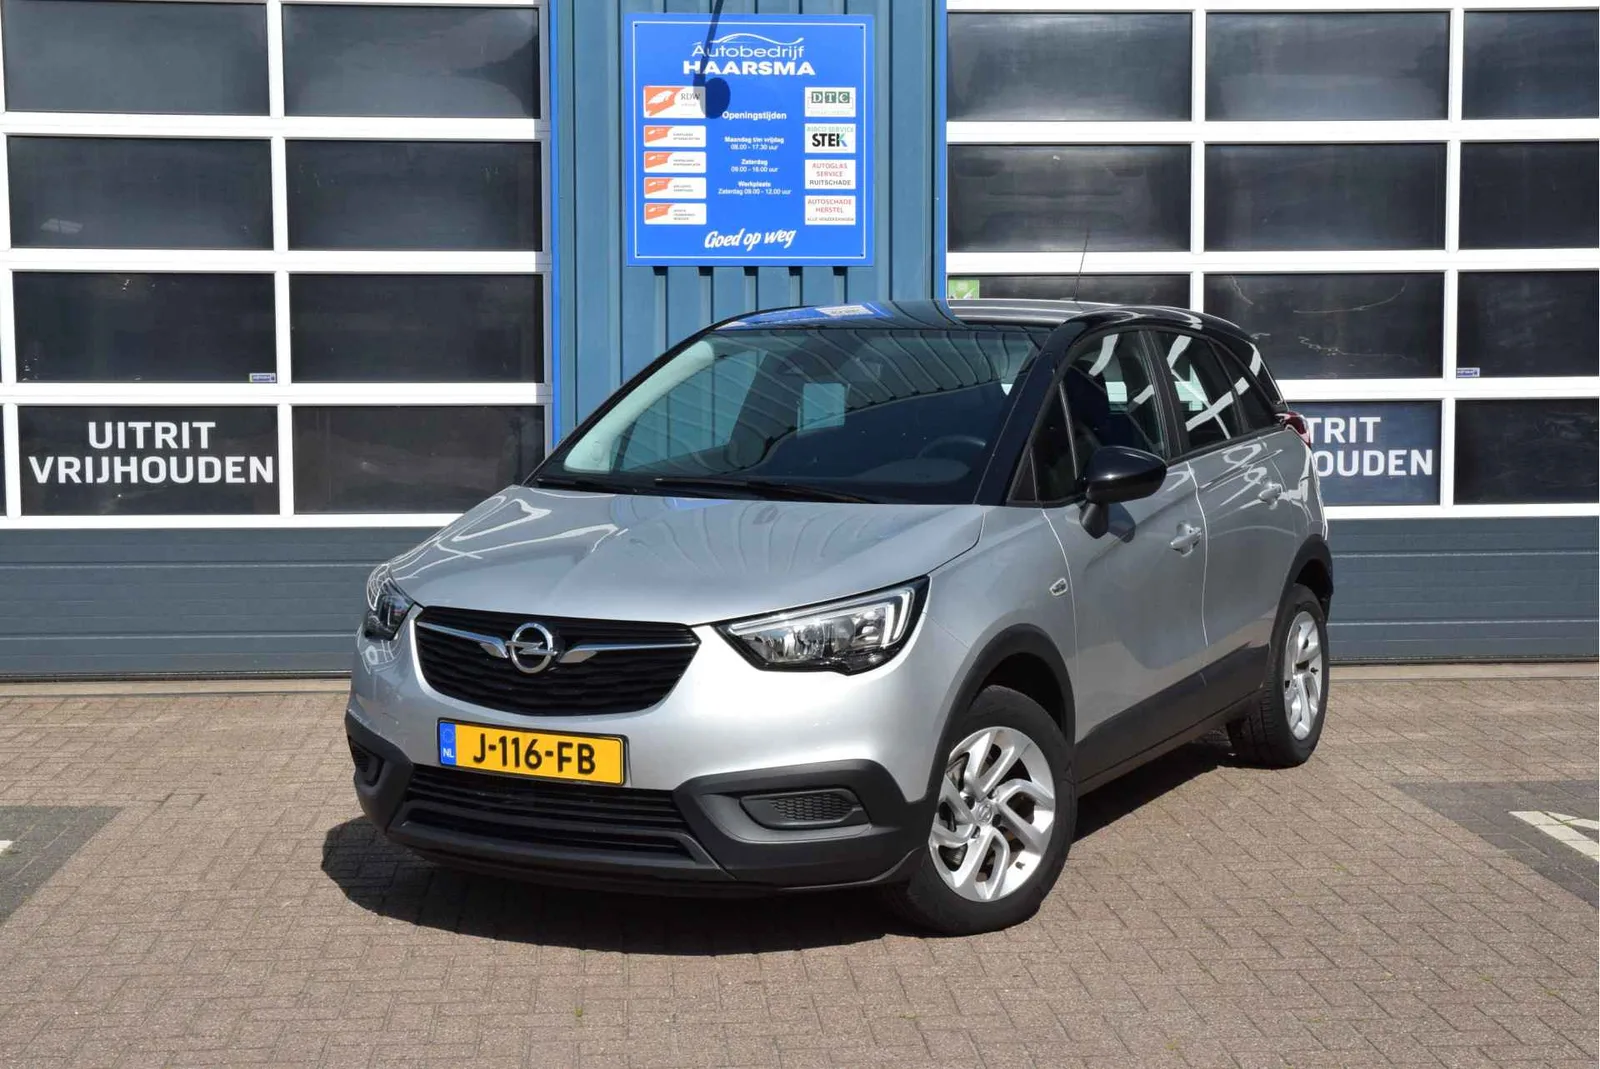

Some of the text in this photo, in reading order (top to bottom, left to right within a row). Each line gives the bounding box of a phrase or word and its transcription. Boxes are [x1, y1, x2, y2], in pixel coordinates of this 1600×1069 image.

[692, 44, 805, 61] Autobedrijf
[683, 60, 816, 76] HAARSMA
[680, 92, 701, 101] RDW
[811, 91, 850, 104] DTC
[722, 111, 787, 121] Openingstijden
[811, 133, 848, 148] STEK
[741, 158, 768, 166] Zaterdag
[812, 162, 848, 170] AUTOGLAS
[816, 170, 843, 178] SERVICE
[718, 188, 744, 196] Zaterdag
[704, 228, 797, 252] Goed op weg
[88, 421, 216, 449] UITRIT
[1306, 416, 1382, 444] TRIT
[28, 455, 274, 484] VRIJHOUDEN
[1312, 449, 1433, 478] OUDEN
[442, 748, 455, 759] NL
[472, 732, 596, 776] J-116-FB
